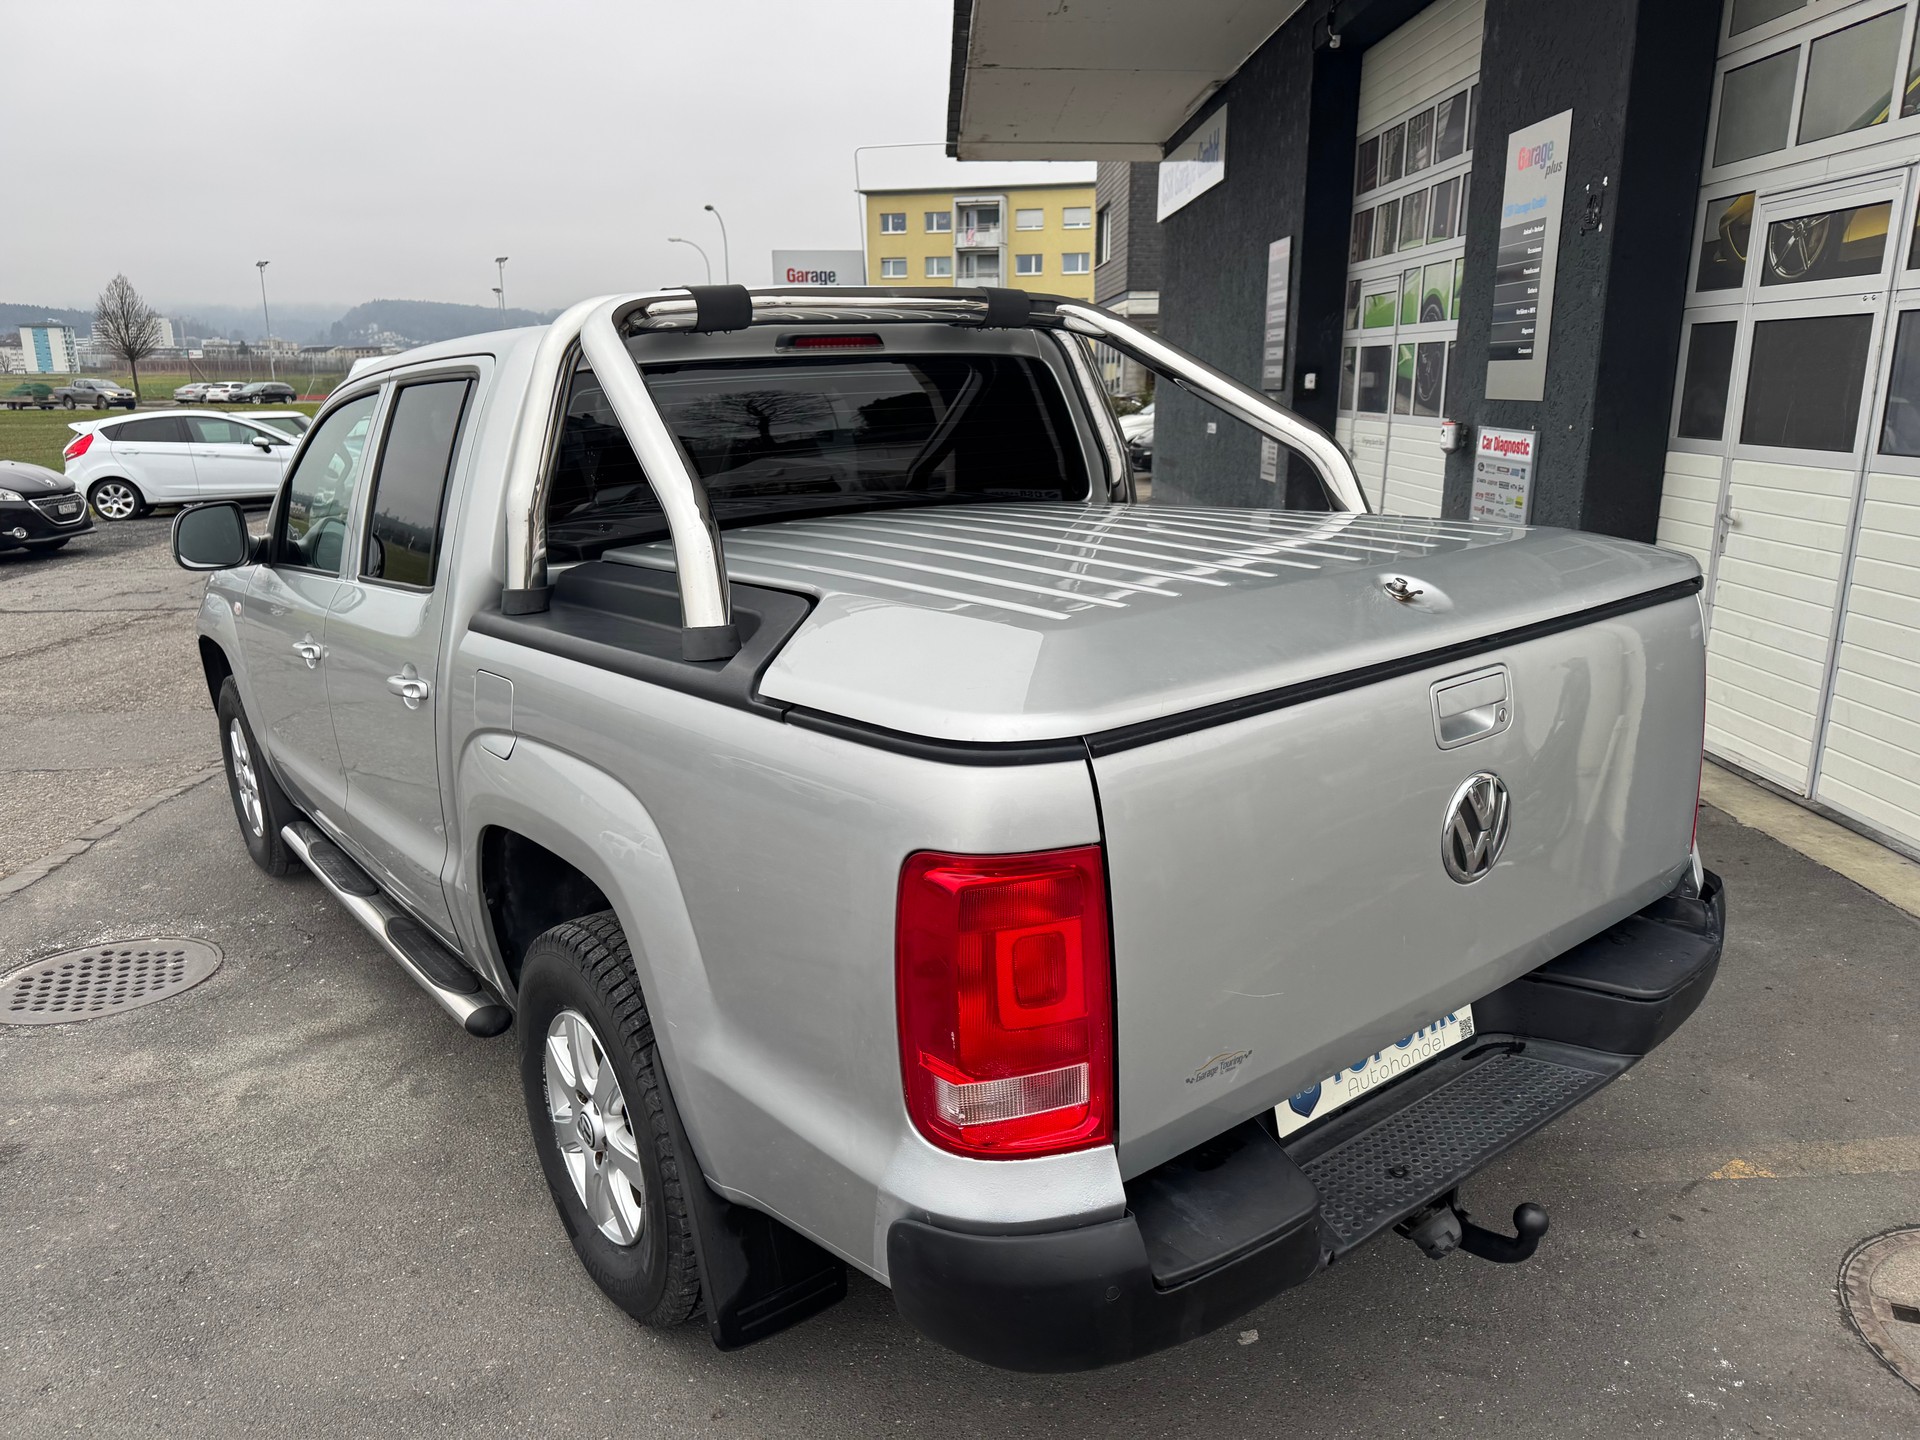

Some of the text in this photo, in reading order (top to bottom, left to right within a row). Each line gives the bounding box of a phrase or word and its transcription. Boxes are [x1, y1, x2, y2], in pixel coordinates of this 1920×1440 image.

[1517, 140, 1554, 172] Garage
[1544, 160, 1563, 180] plus
[786, 267, 836, 285] Garage
[1482, 435, 1530, 456] Car Diagnostic
[1347, 1031, 1446, 1096] Autohandel
